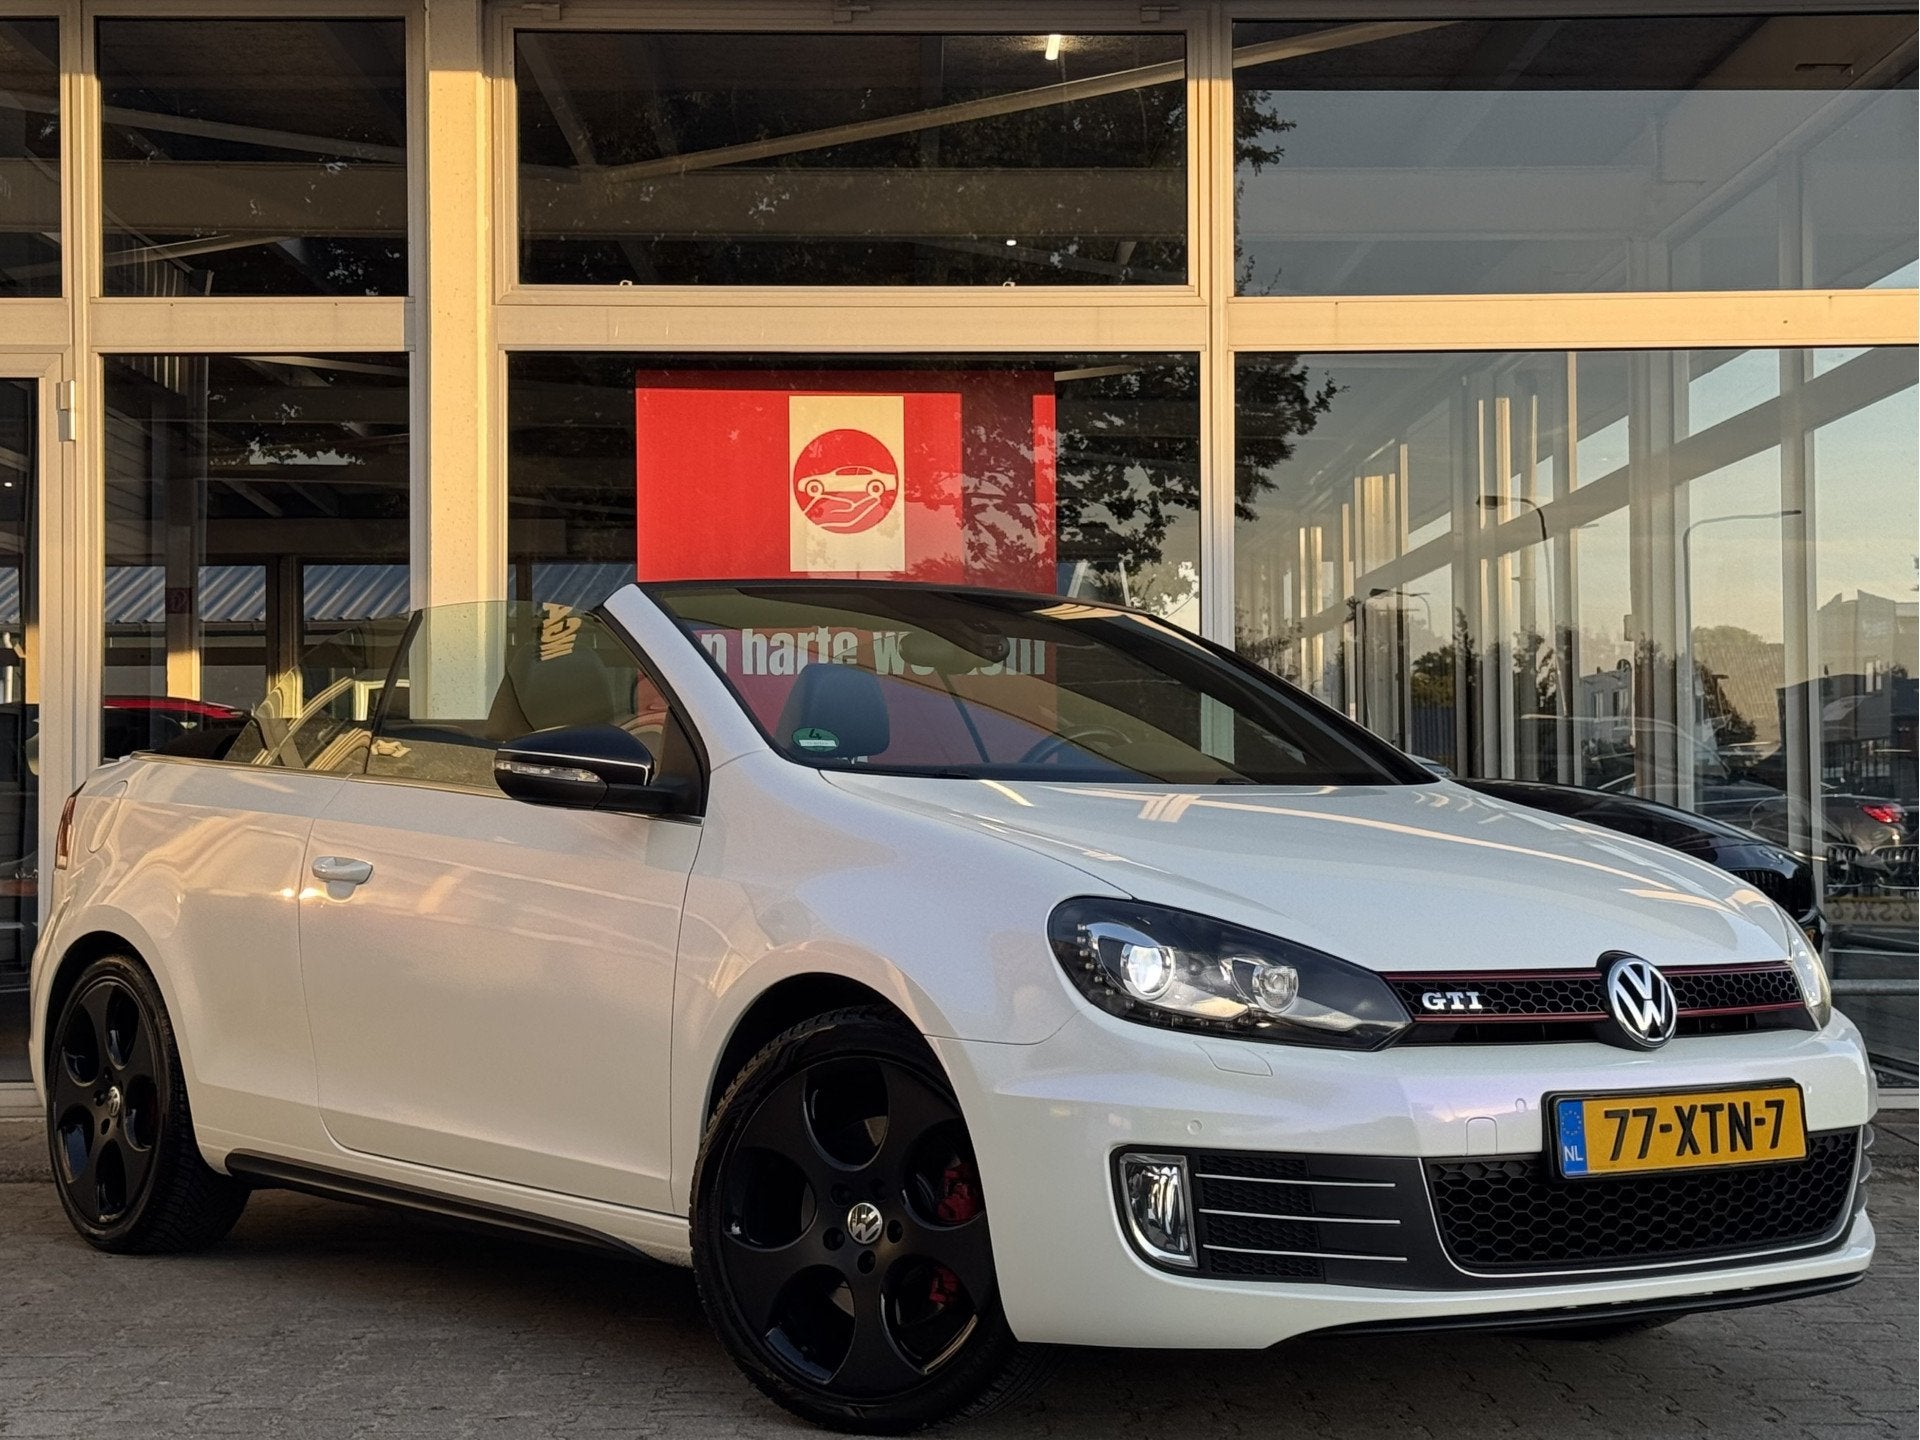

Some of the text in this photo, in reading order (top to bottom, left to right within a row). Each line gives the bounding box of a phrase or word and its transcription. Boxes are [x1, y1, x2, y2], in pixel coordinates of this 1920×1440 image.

[741, 626, 858, 676] harte
[1421, 991, 1483, 1010] GTI
[1604, 1099, 1785, 1161] 77-XTN-7
[1564, 1146, 1584, 1162] NL
